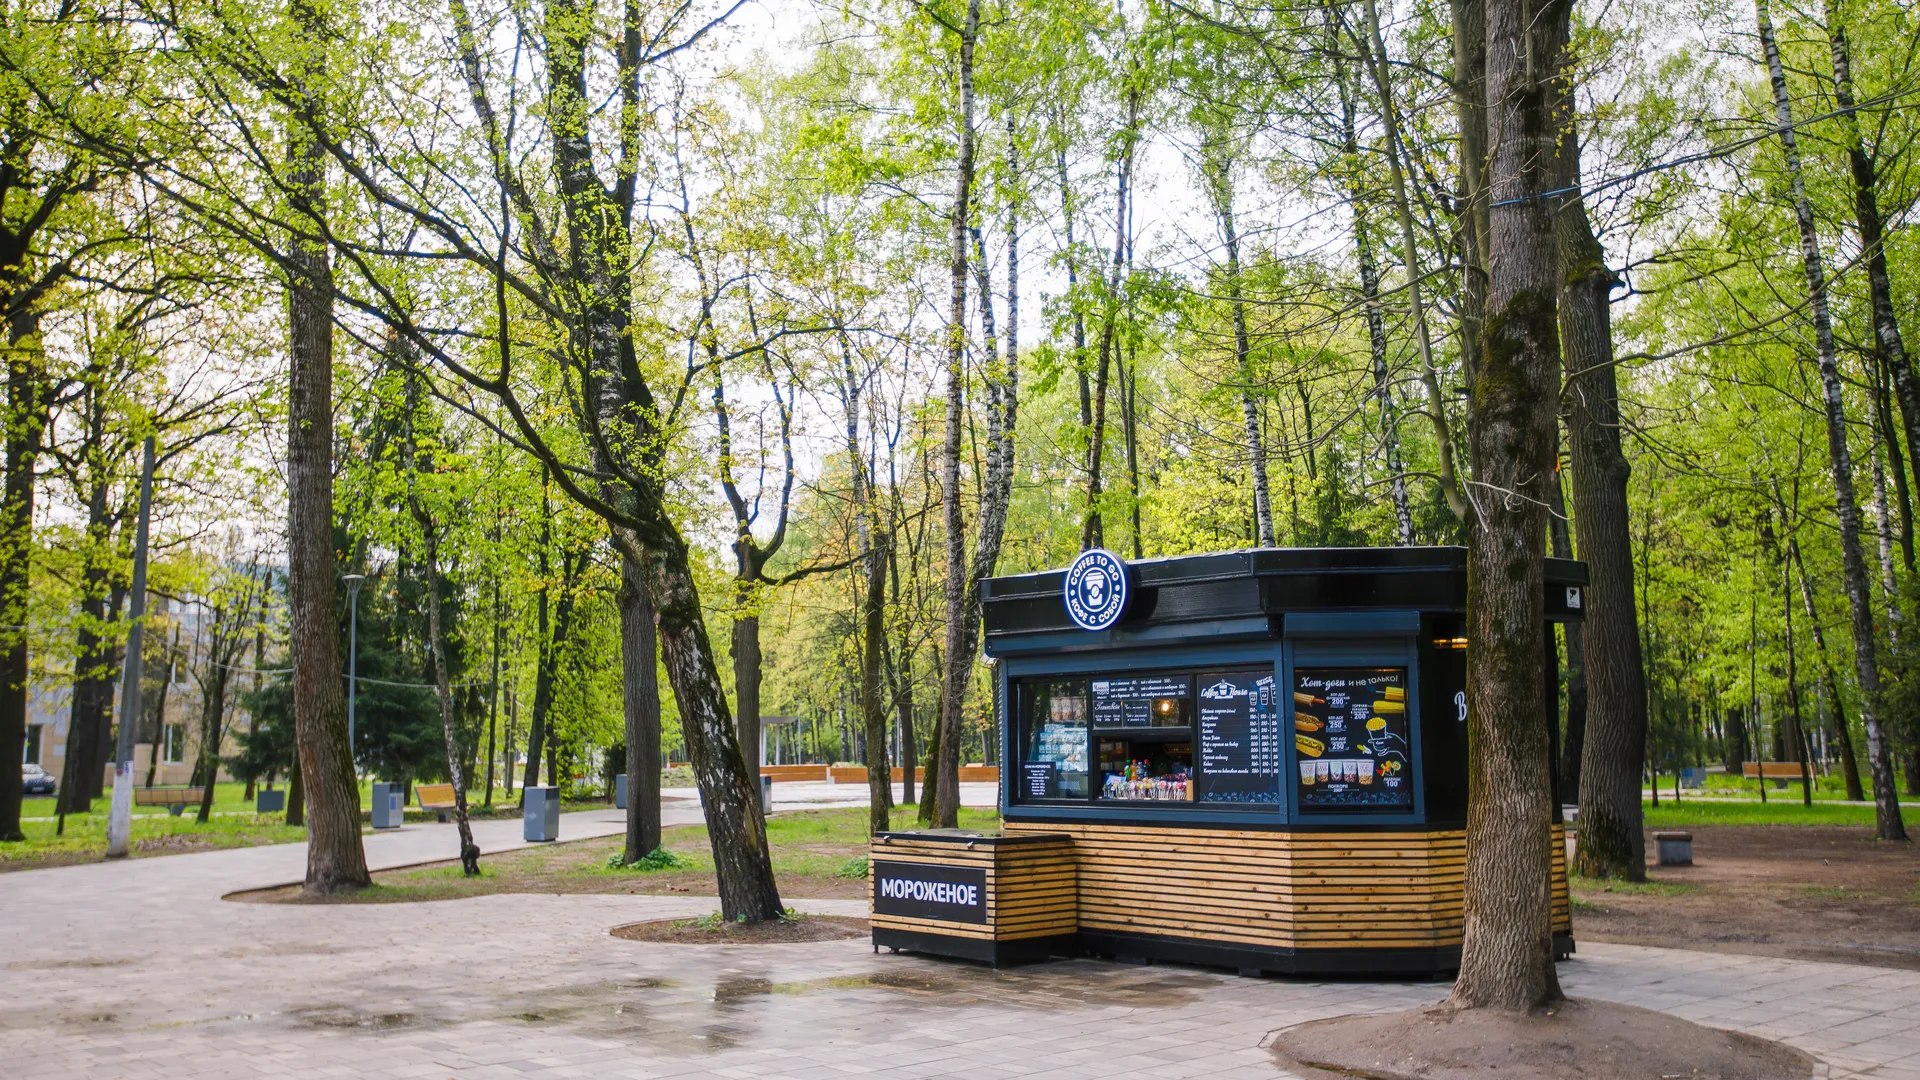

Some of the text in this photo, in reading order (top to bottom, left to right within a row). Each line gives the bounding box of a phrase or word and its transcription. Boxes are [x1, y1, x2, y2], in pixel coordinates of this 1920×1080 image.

[1071, 556, 1119, 585] COFFEE TO GO
[1071, 594, 1120, 624] КОФЕ С СОБОЙ
[1201, 688, 1248, 698] Coffee House
[1301, 677, 1345, 691] Хот-доги
[882, 878, 977, 906] МОРОЖЕНОЕ
